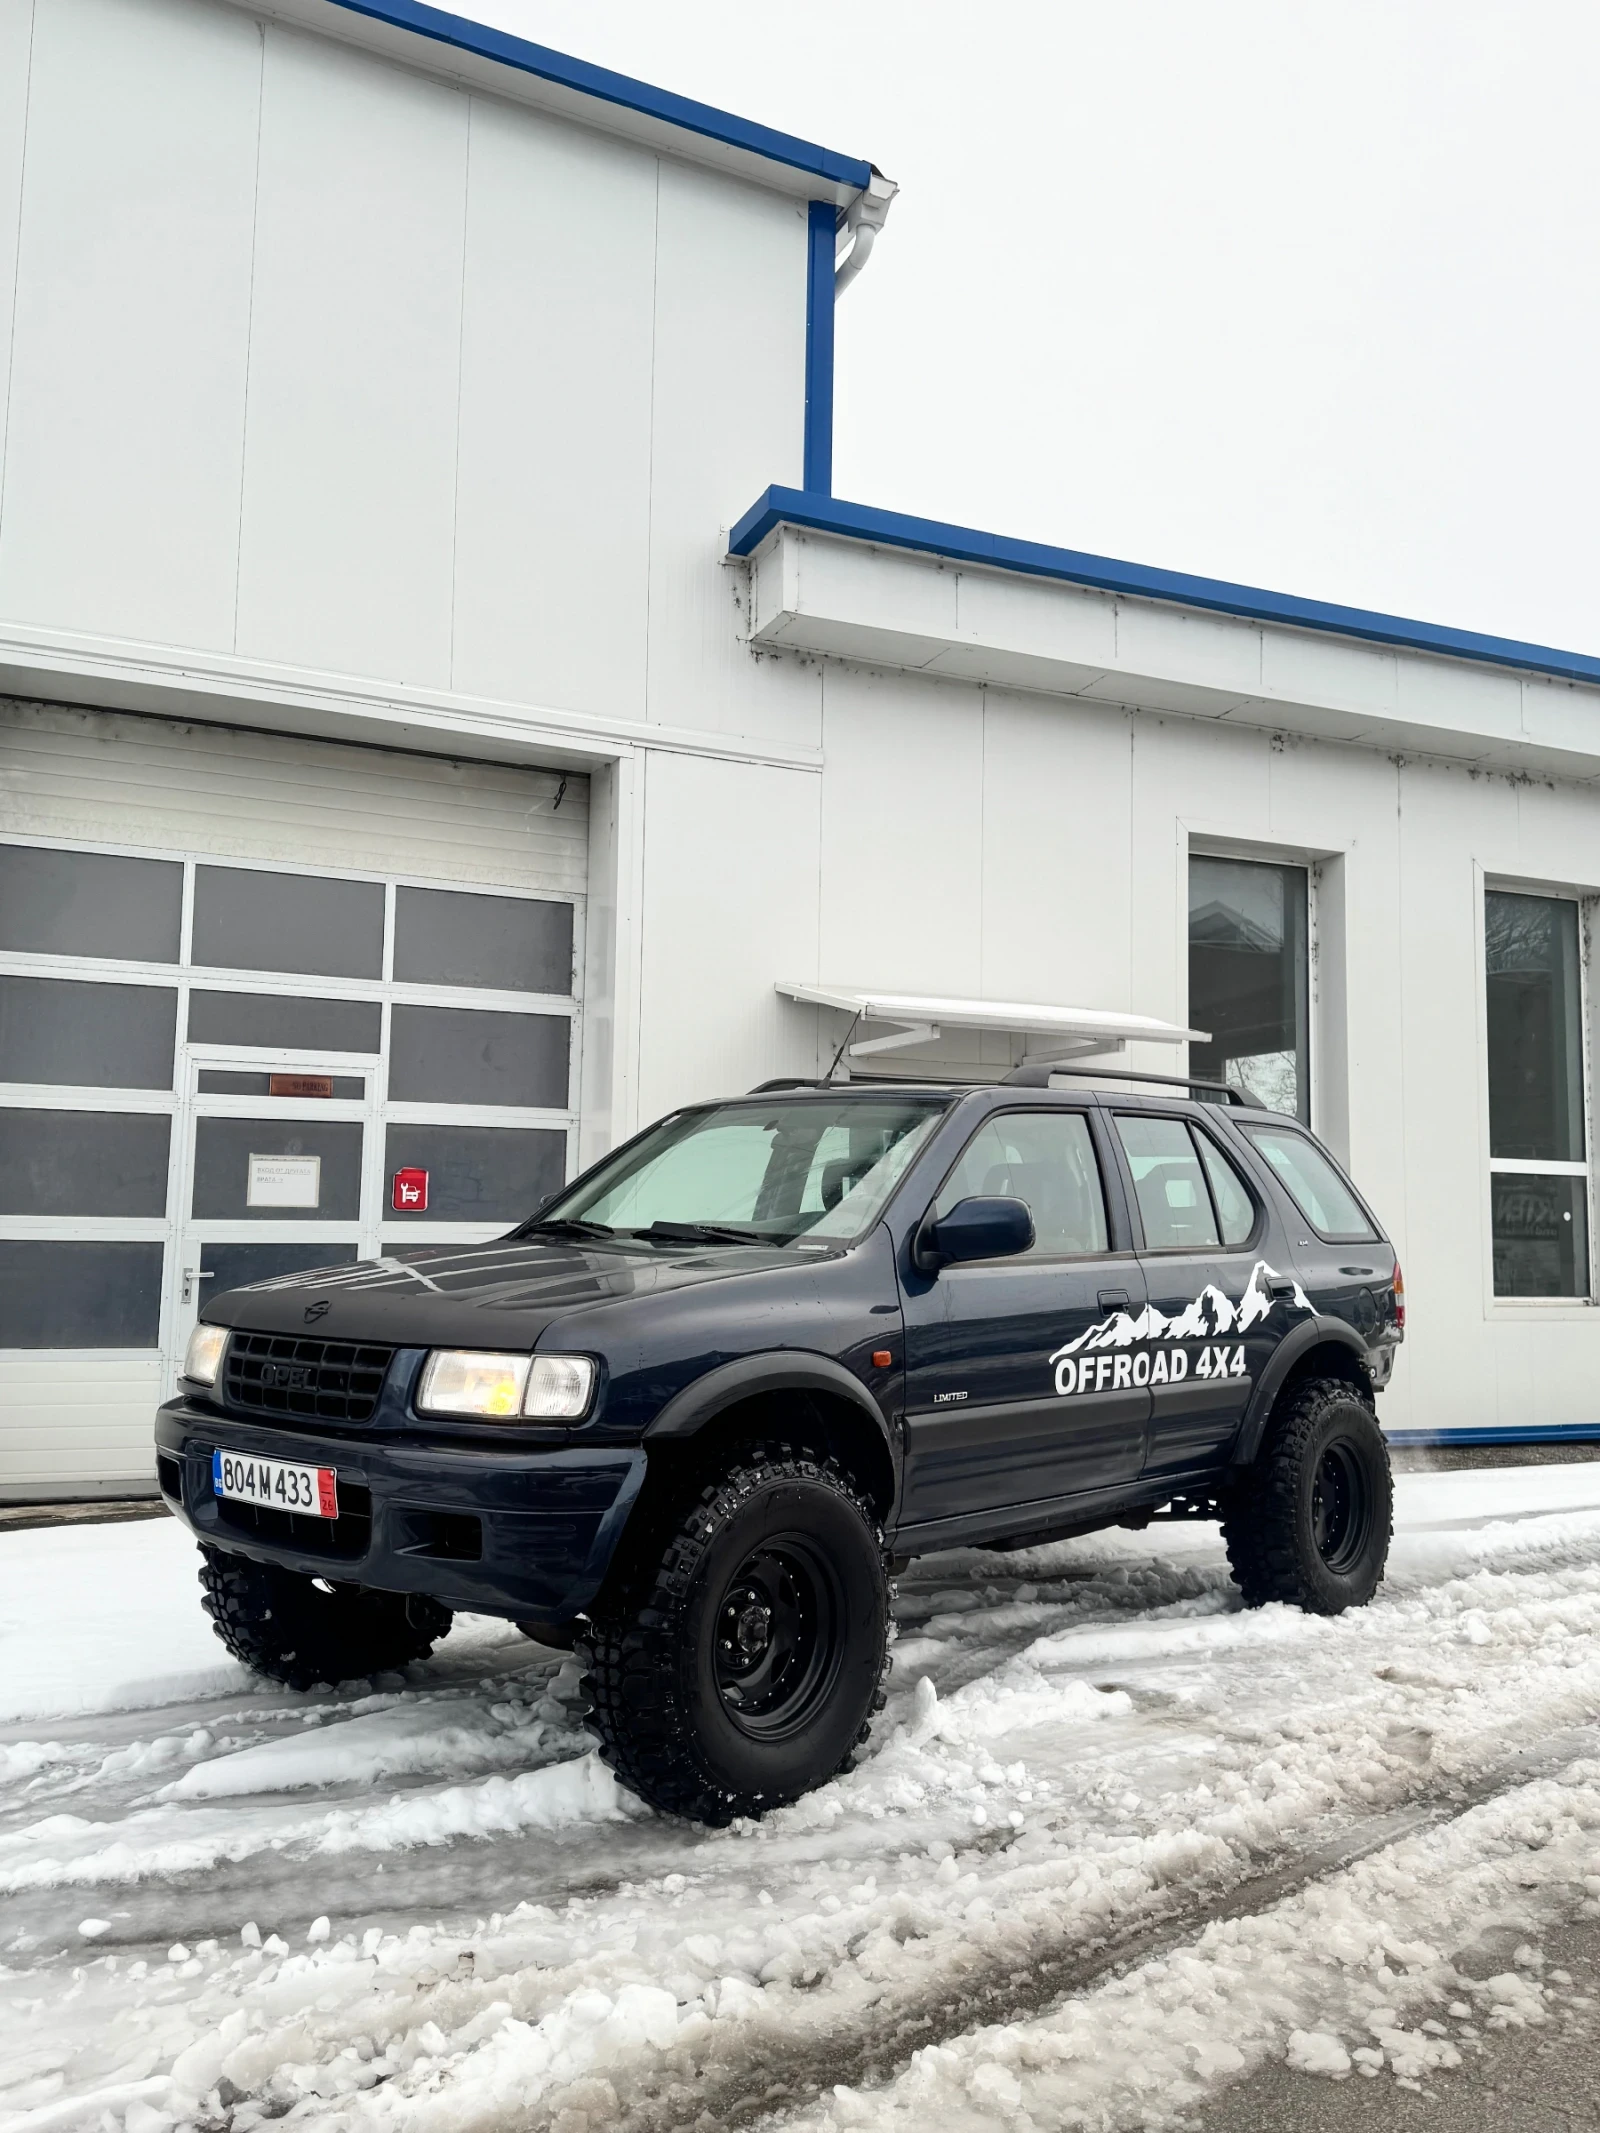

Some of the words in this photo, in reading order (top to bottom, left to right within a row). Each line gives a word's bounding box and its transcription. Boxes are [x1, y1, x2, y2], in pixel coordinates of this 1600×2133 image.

[302, 1081, 328, 1092] PARKING
[1054, 1349, 1188, 1395] OFFROAD
[1195, 1345, 1247, 1379] 4X4
[261, 1363, 317, 1391] OPEL
[933, 1391, 968, 1403] LIMITED
[322, 1499, 333, 1511] 26
